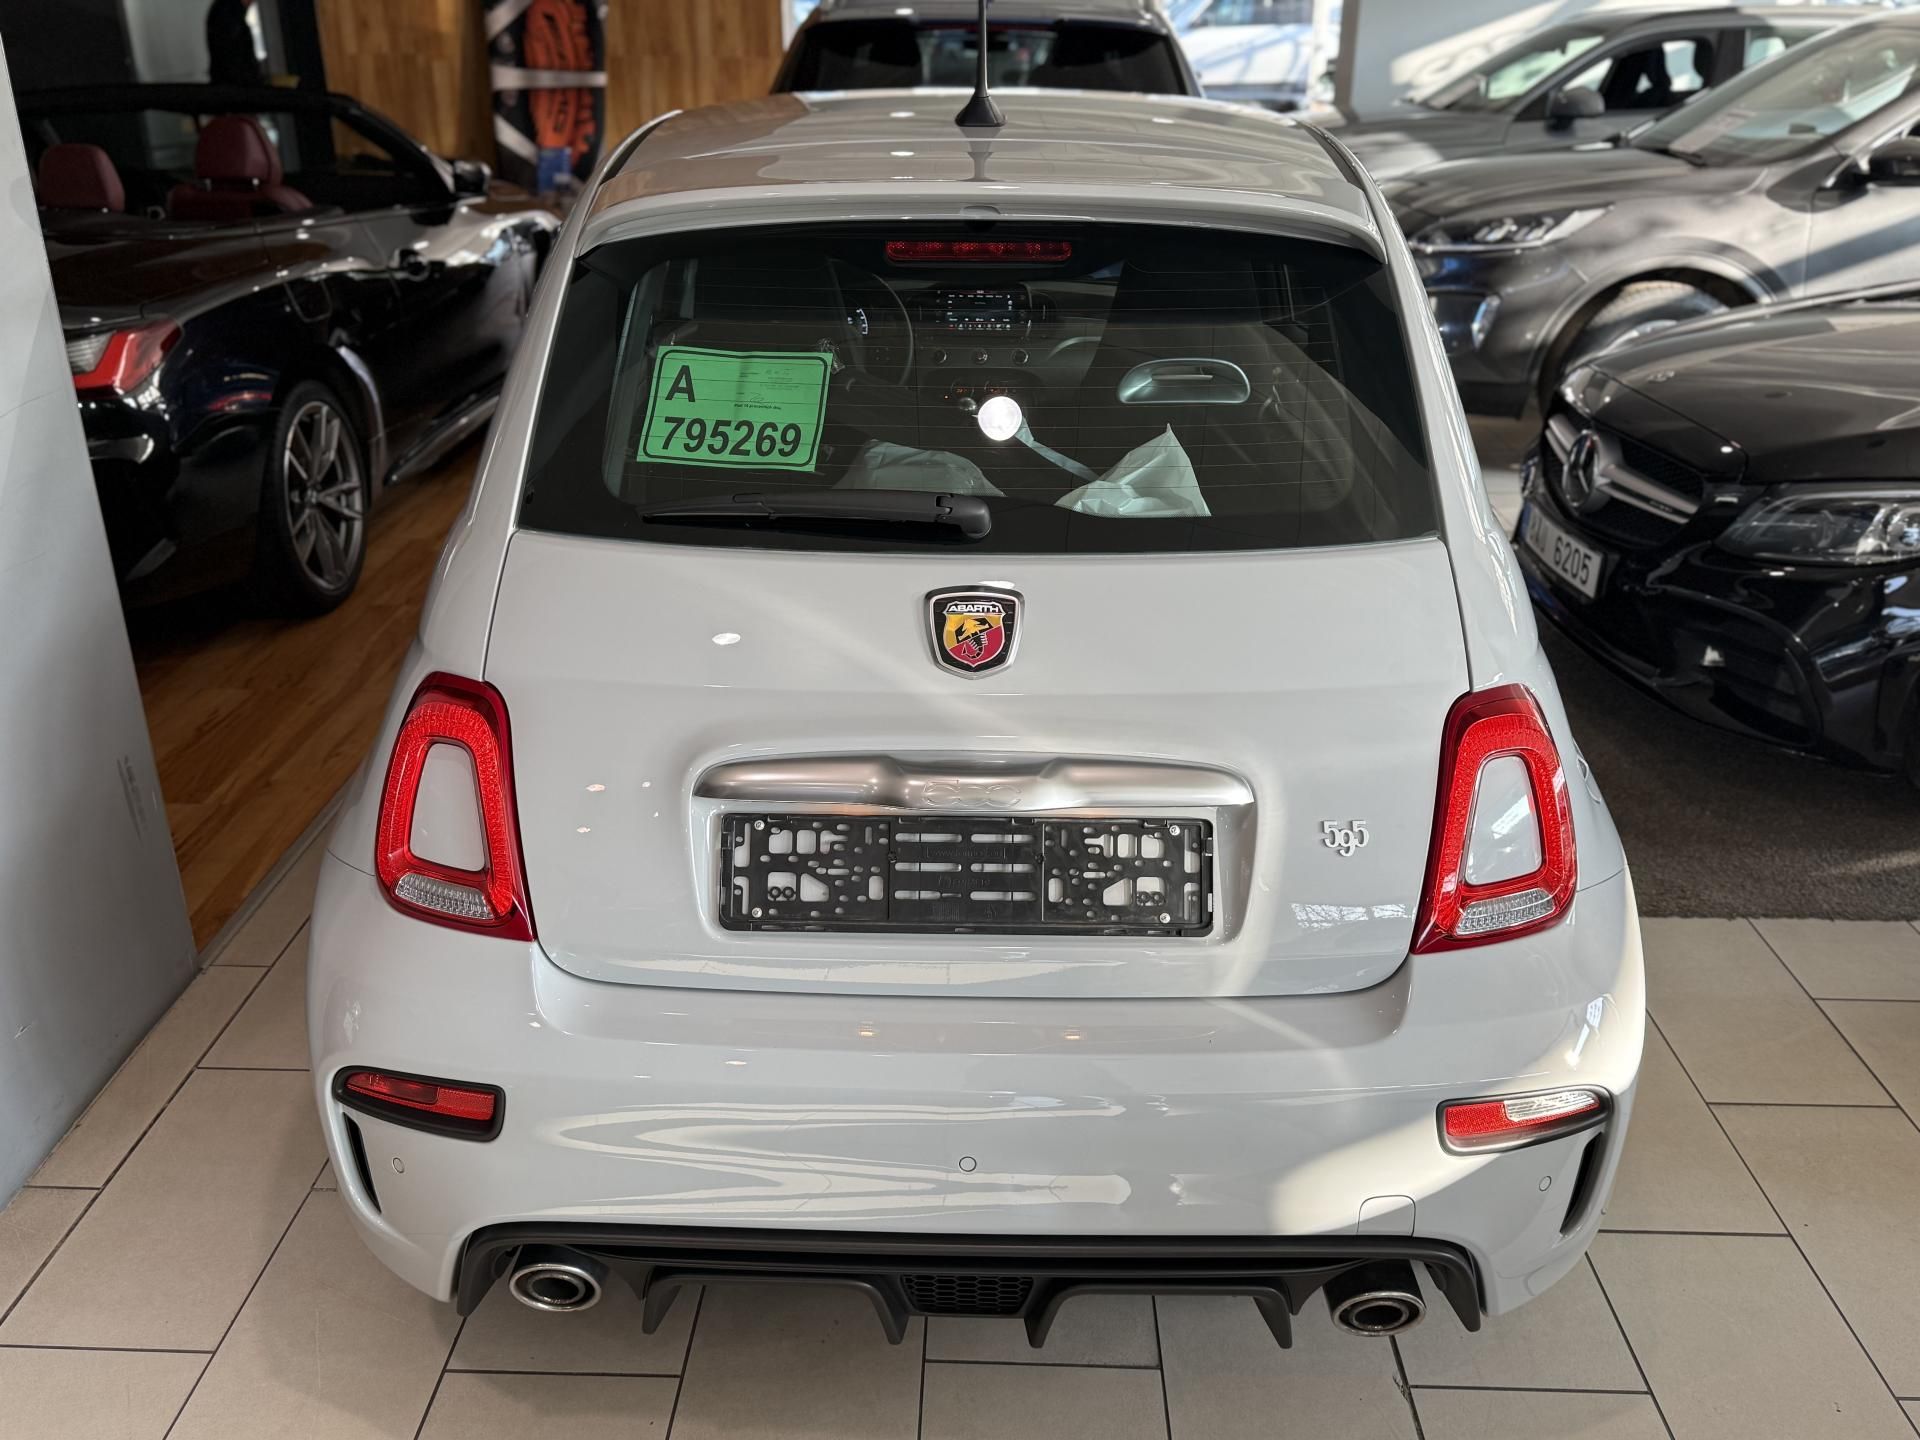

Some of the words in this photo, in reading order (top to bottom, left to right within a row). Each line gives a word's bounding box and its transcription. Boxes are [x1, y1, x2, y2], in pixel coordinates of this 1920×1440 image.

[665, 365, 696, 403] A
[662, 416, 801, 457] 795269
[1553, 535, 1592, 585] 6205
[948, 604, 999, 613] ABARTH
[1322, 820, 1370, 857] 595
